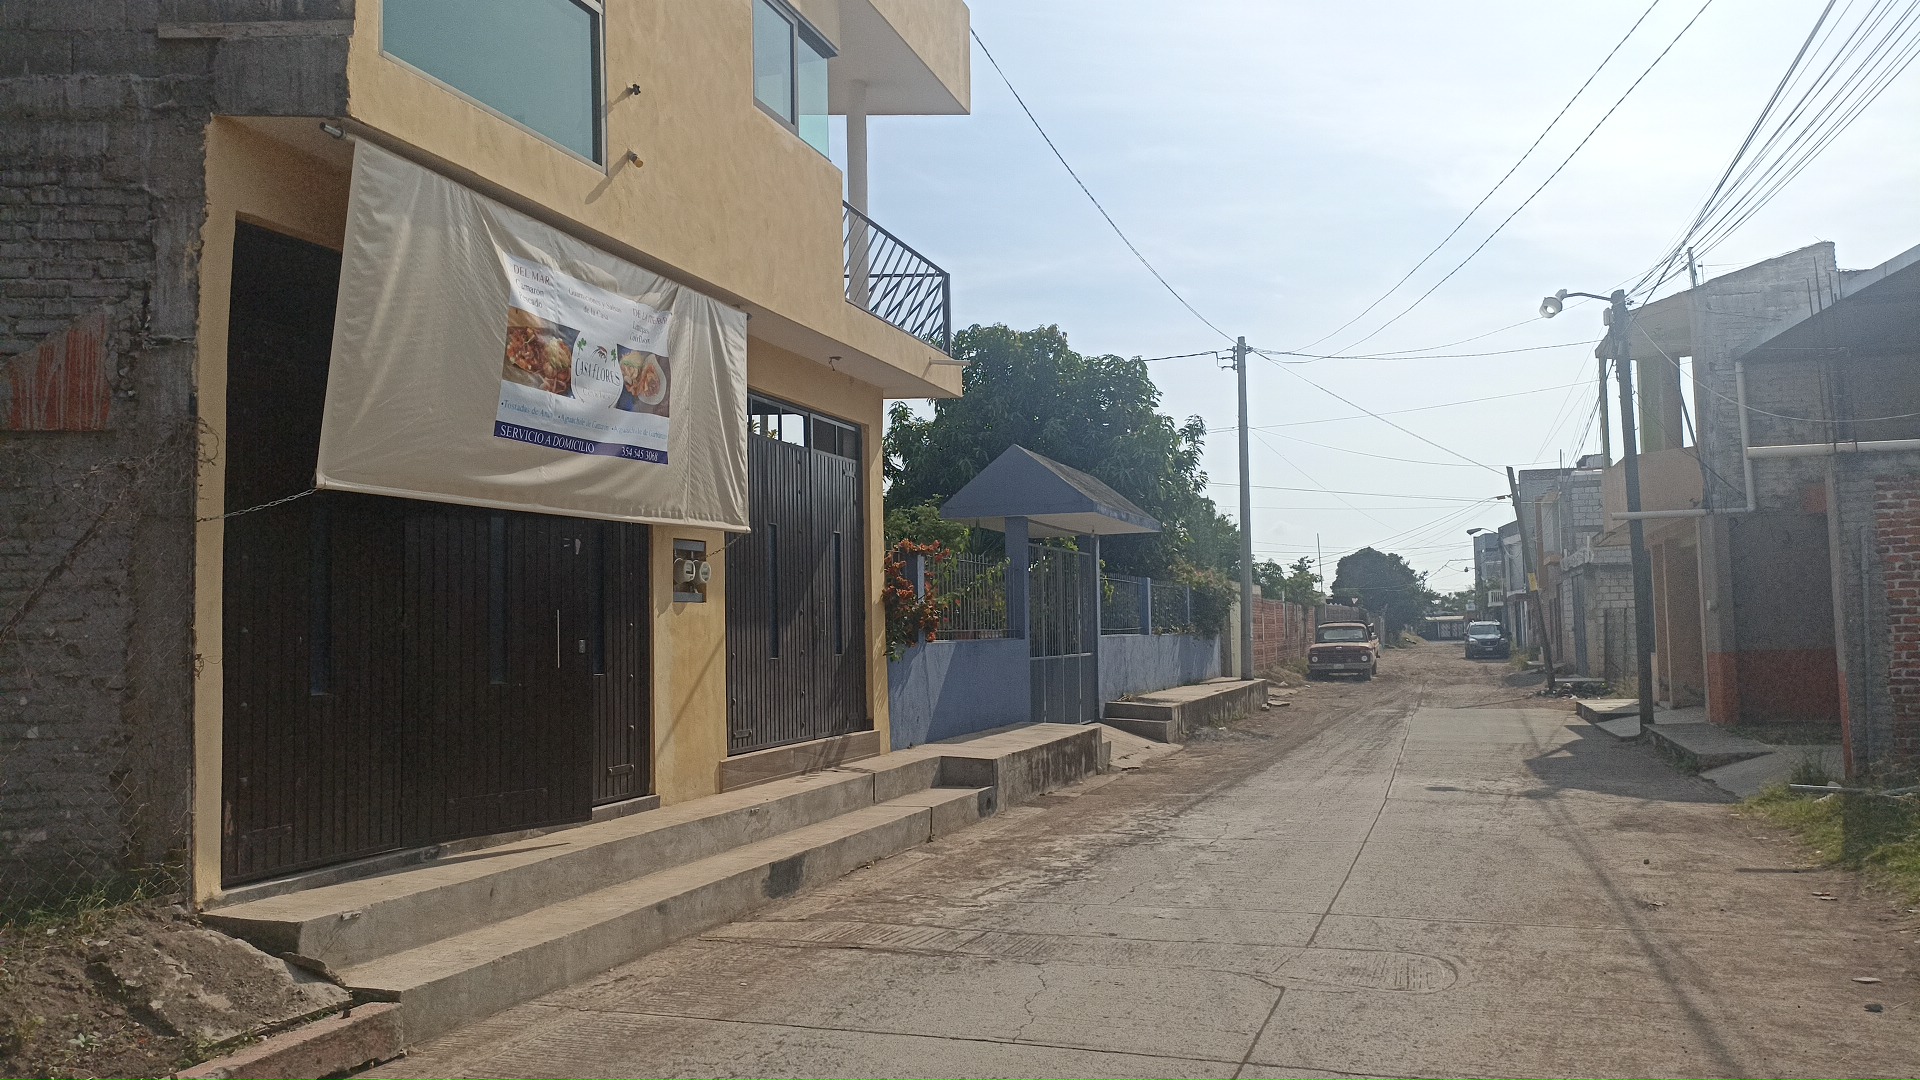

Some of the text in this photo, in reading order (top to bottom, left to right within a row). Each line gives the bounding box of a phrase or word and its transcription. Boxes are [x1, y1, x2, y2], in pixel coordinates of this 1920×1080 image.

[513, 264, 553, 287] DEL MAR
[592, 364, 620, 386] FLORES
[504, 400, 529, 414] Tostadas
[531, 407, 539, 415] de
[500, 425, 595, 453] SERVICIO A DOMICILIO
[622, 446, 632, 457] 354
[633, 448, 644, 459] 545
